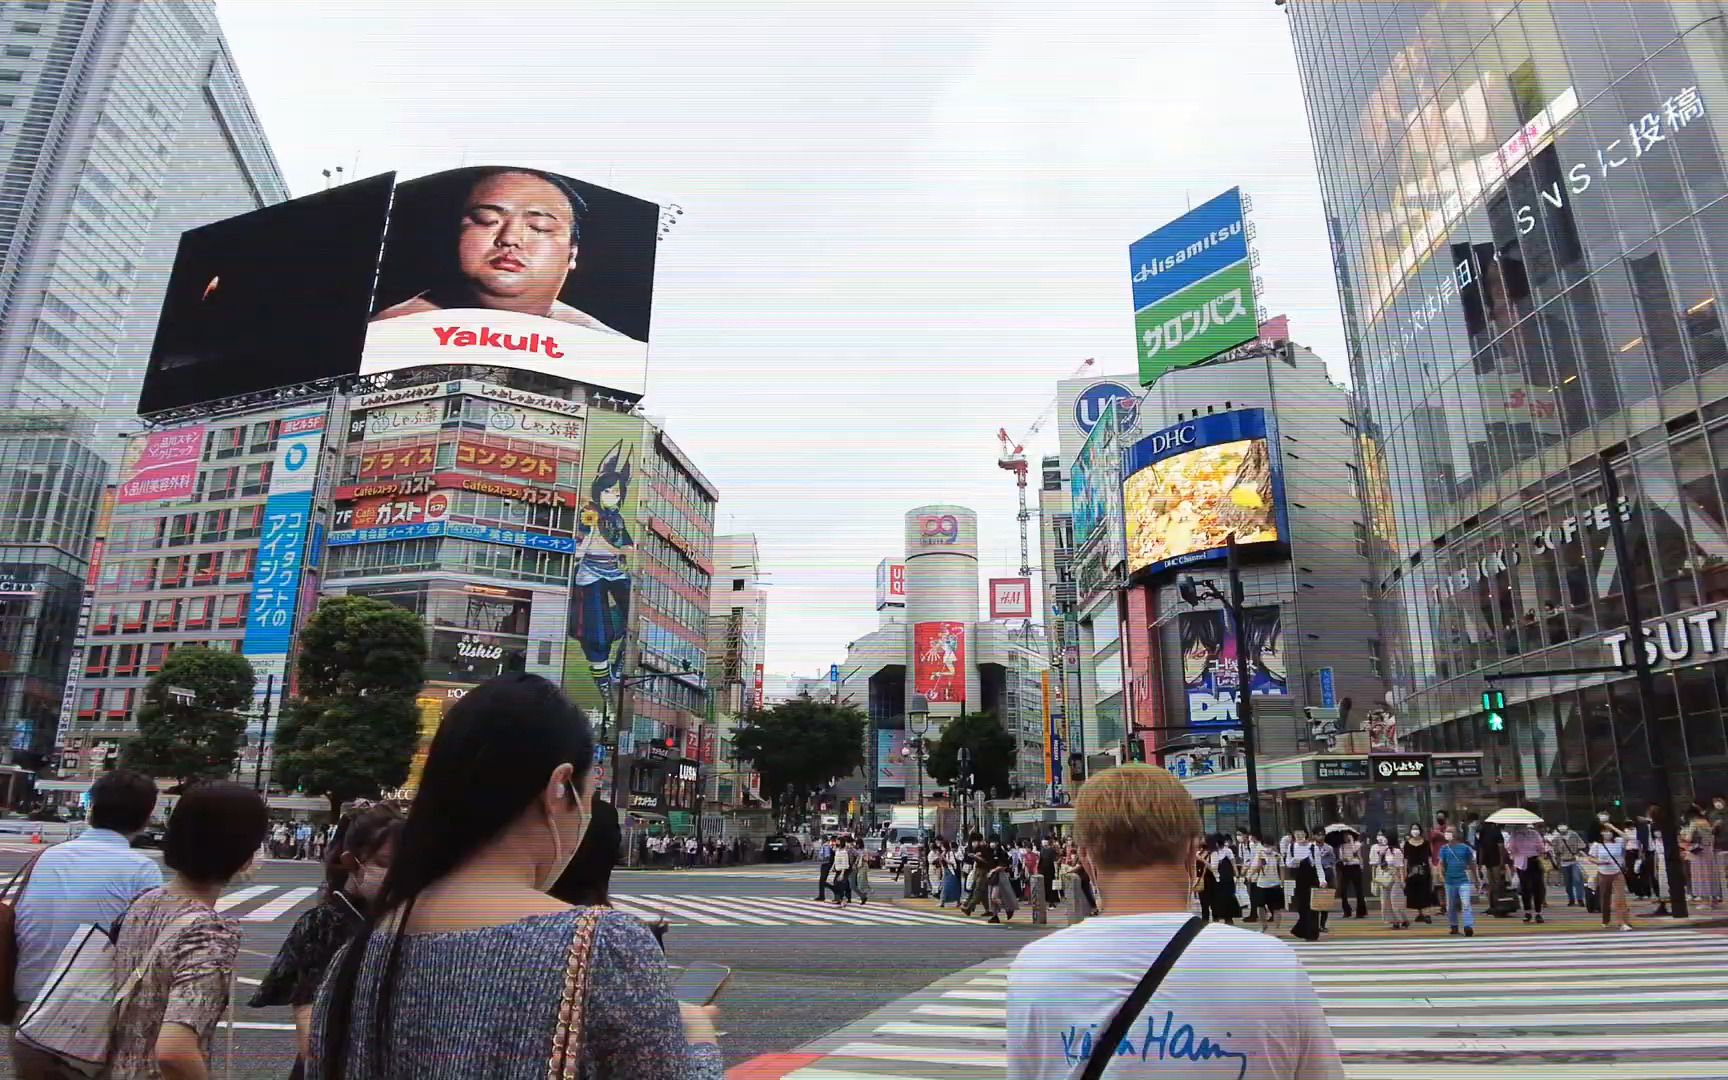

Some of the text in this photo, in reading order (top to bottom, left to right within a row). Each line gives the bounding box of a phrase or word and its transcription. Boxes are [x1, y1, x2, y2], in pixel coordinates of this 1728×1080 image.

[1133, 220, 1241, 283] Hisamitsu
[1143, 288, 1247, 358] サロンパス
[433, 326, 564, 358] Yakult
[351, 420, 366, 432] 9F
[520, 412, 580, 440] しゃぶ葉
[1152, 425, 1196, 455] DHC
[458, 445, 553, 476] コンタクト
[399, 477, 436, 495] ガスト
[521, 487, 566, 507] ガスト
[335, 510, 353, 524] 7F
[376, 501, 421, 525] ガスト
[254, 514, 287, 628] アイシティ
[272, 512, 302, 627] コンタクトの
[1603, 609, 1728, 668] TSUT
